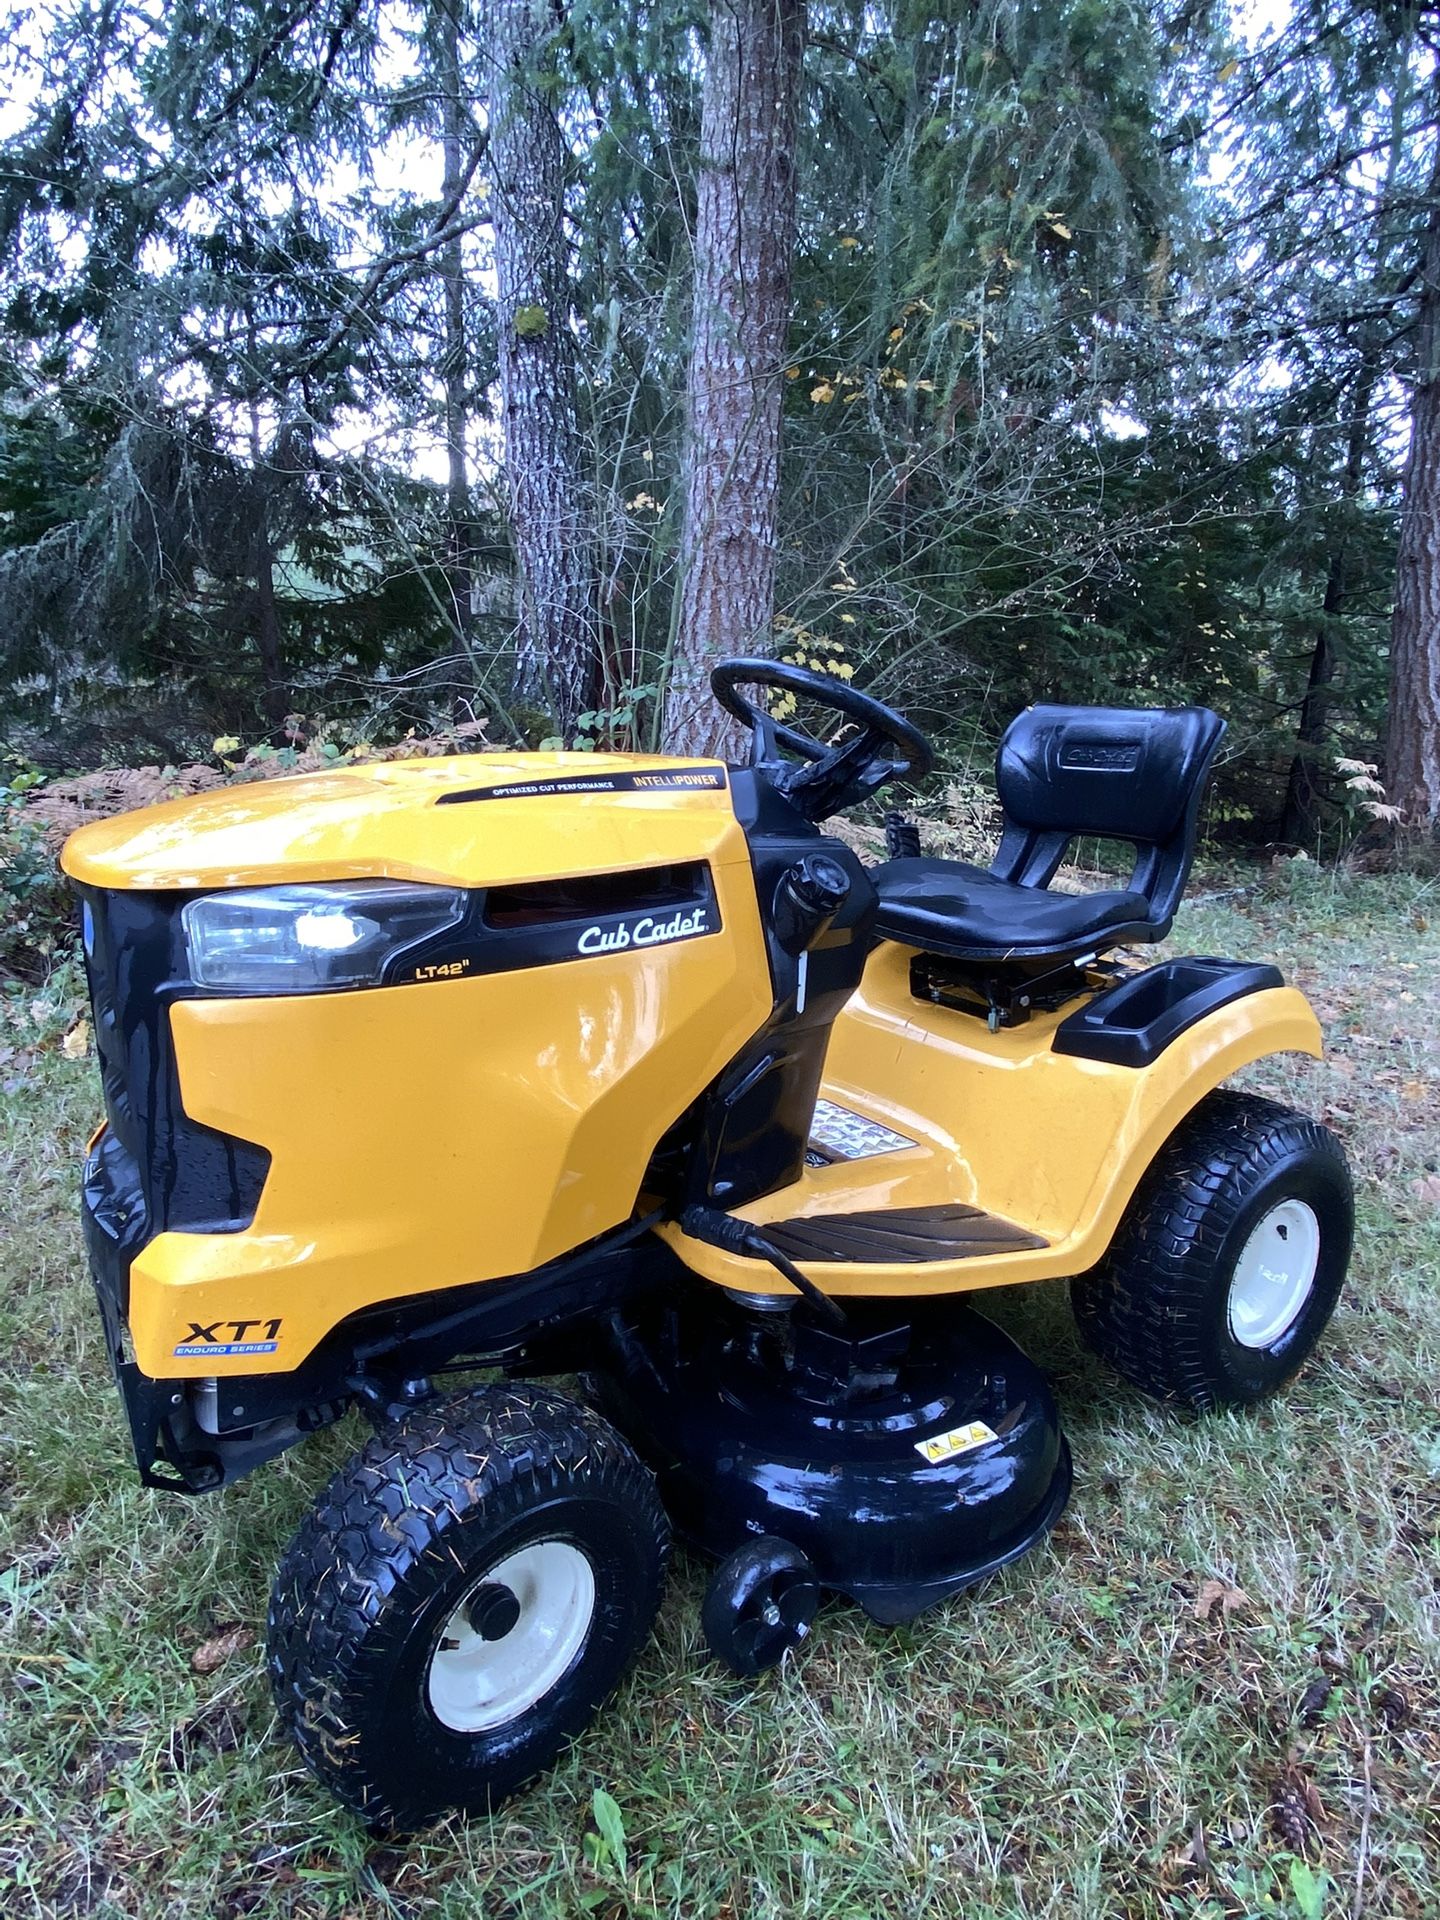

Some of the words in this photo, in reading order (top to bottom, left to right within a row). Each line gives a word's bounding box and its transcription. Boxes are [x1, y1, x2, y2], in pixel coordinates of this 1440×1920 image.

[492, 785, 538, 796] OPTIMIZED
[539, 784, 556, 792] CUT
[557, 781, 615, 791] PERFORMANCE
[633, 774, 719, 788] INTELLIPOWER
[577, 926, 631, 955] Cub
[632, 908, 707, 946] Cadet
[415, 959, 470, 980] LT42"
[178, 1318, 283, 1344] XT1
[175, 1345, 227, 1355] ENDURO
[229, 1343, 275, 1353] SERIES
